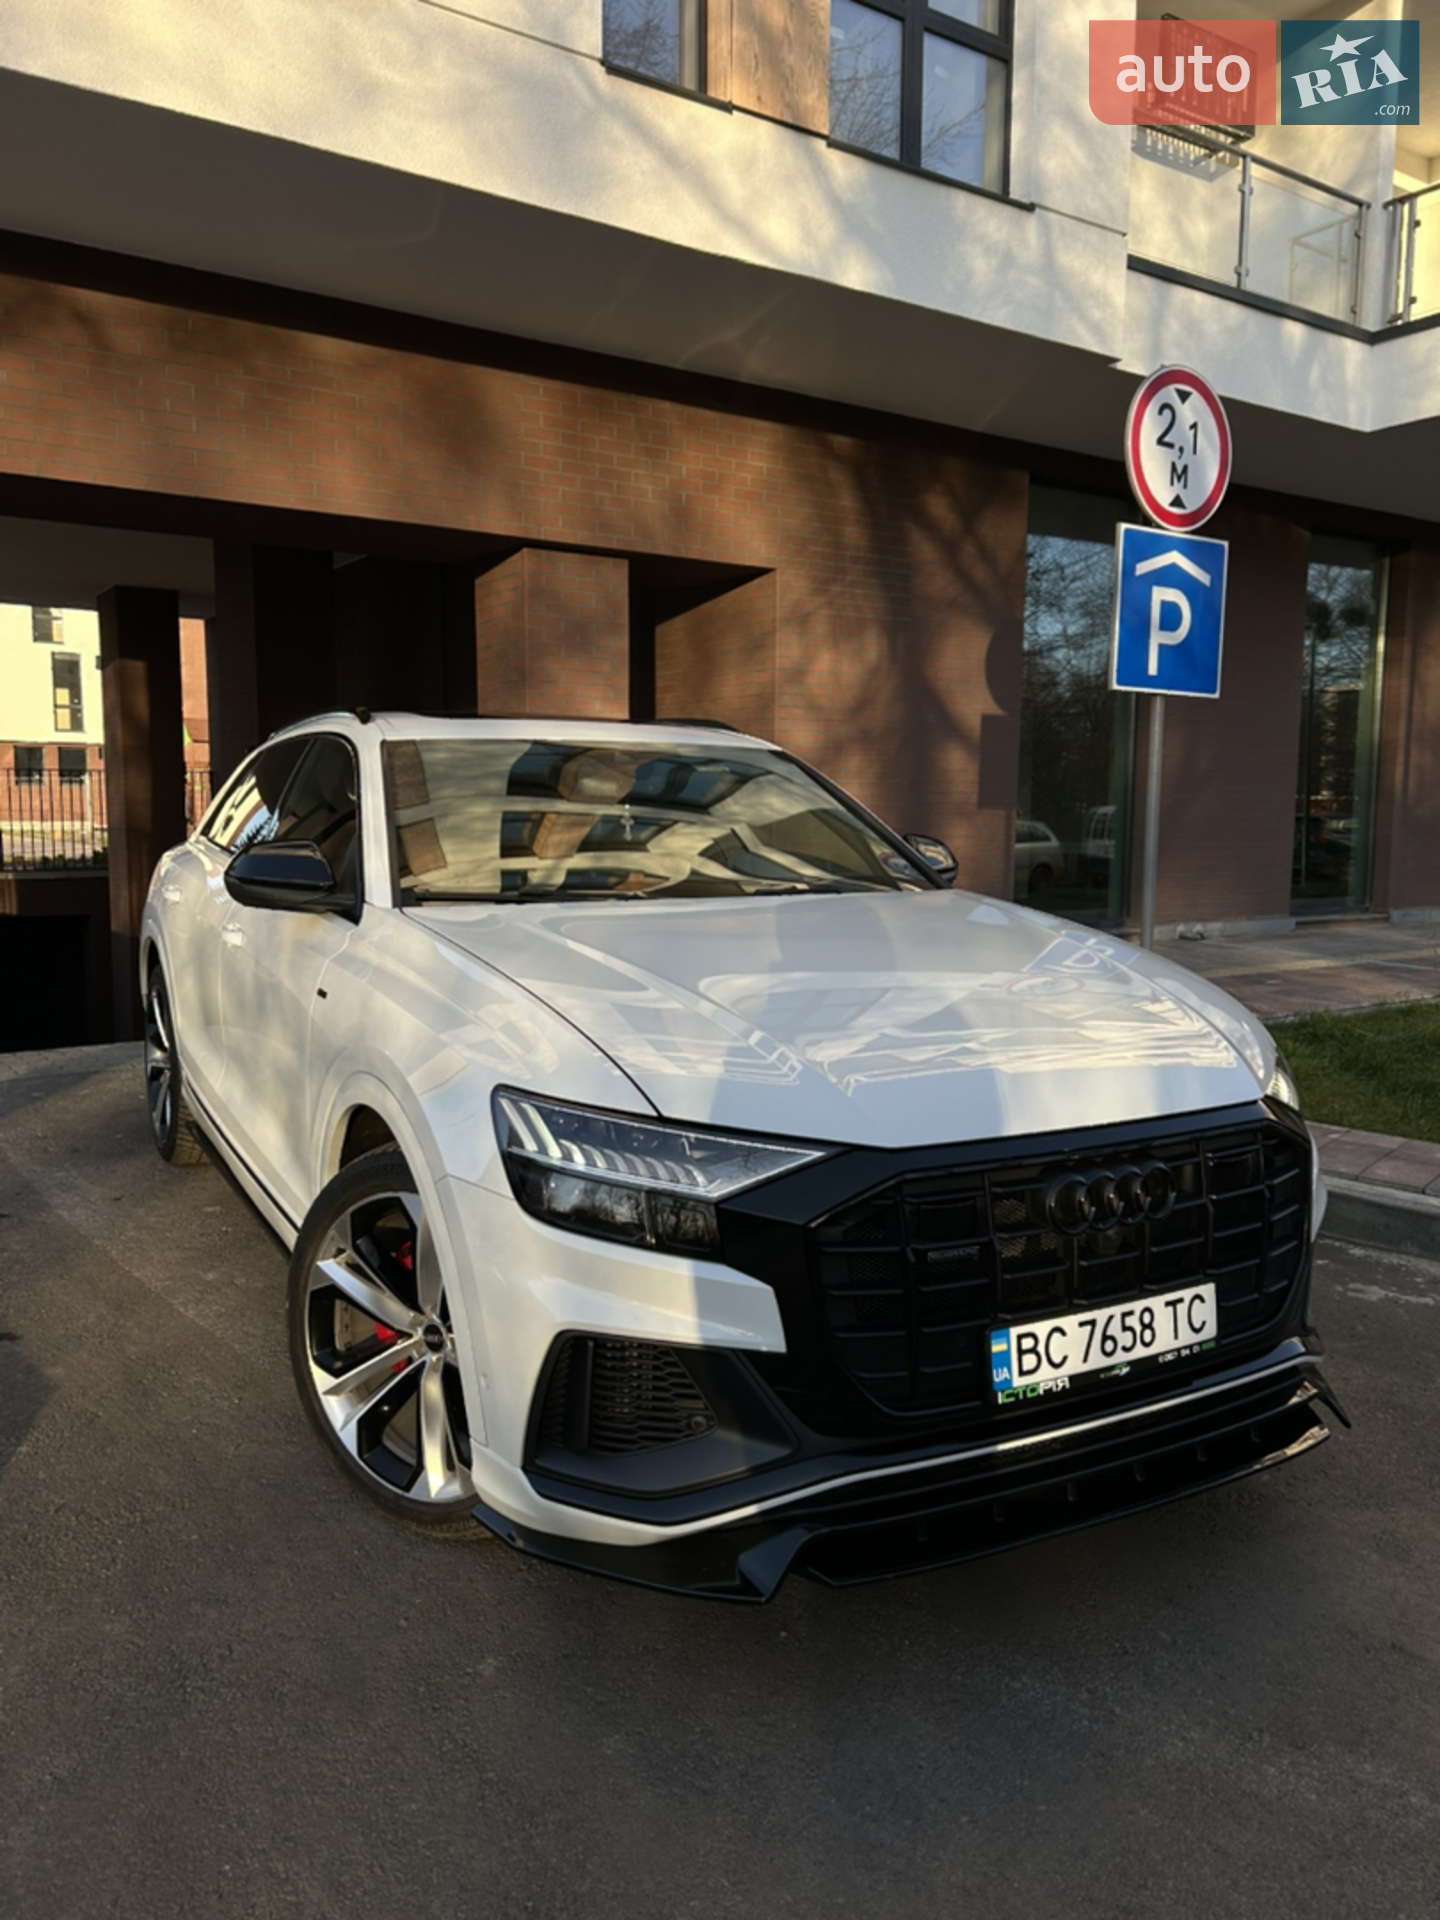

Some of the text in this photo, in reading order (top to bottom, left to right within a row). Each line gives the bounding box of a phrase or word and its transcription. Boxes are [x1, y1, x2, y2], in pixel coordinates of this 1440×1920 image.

[1156, 402, 1199, 459] 2,1
[1148, 585, 1192, 676] P
[1016, 1326, 1069, 1377] BC
[1078, 1307, 1156, 1364] 7658
[1164, 1293, 1207, 1341] TC
[993, 1367, 1010, 1382] UA
